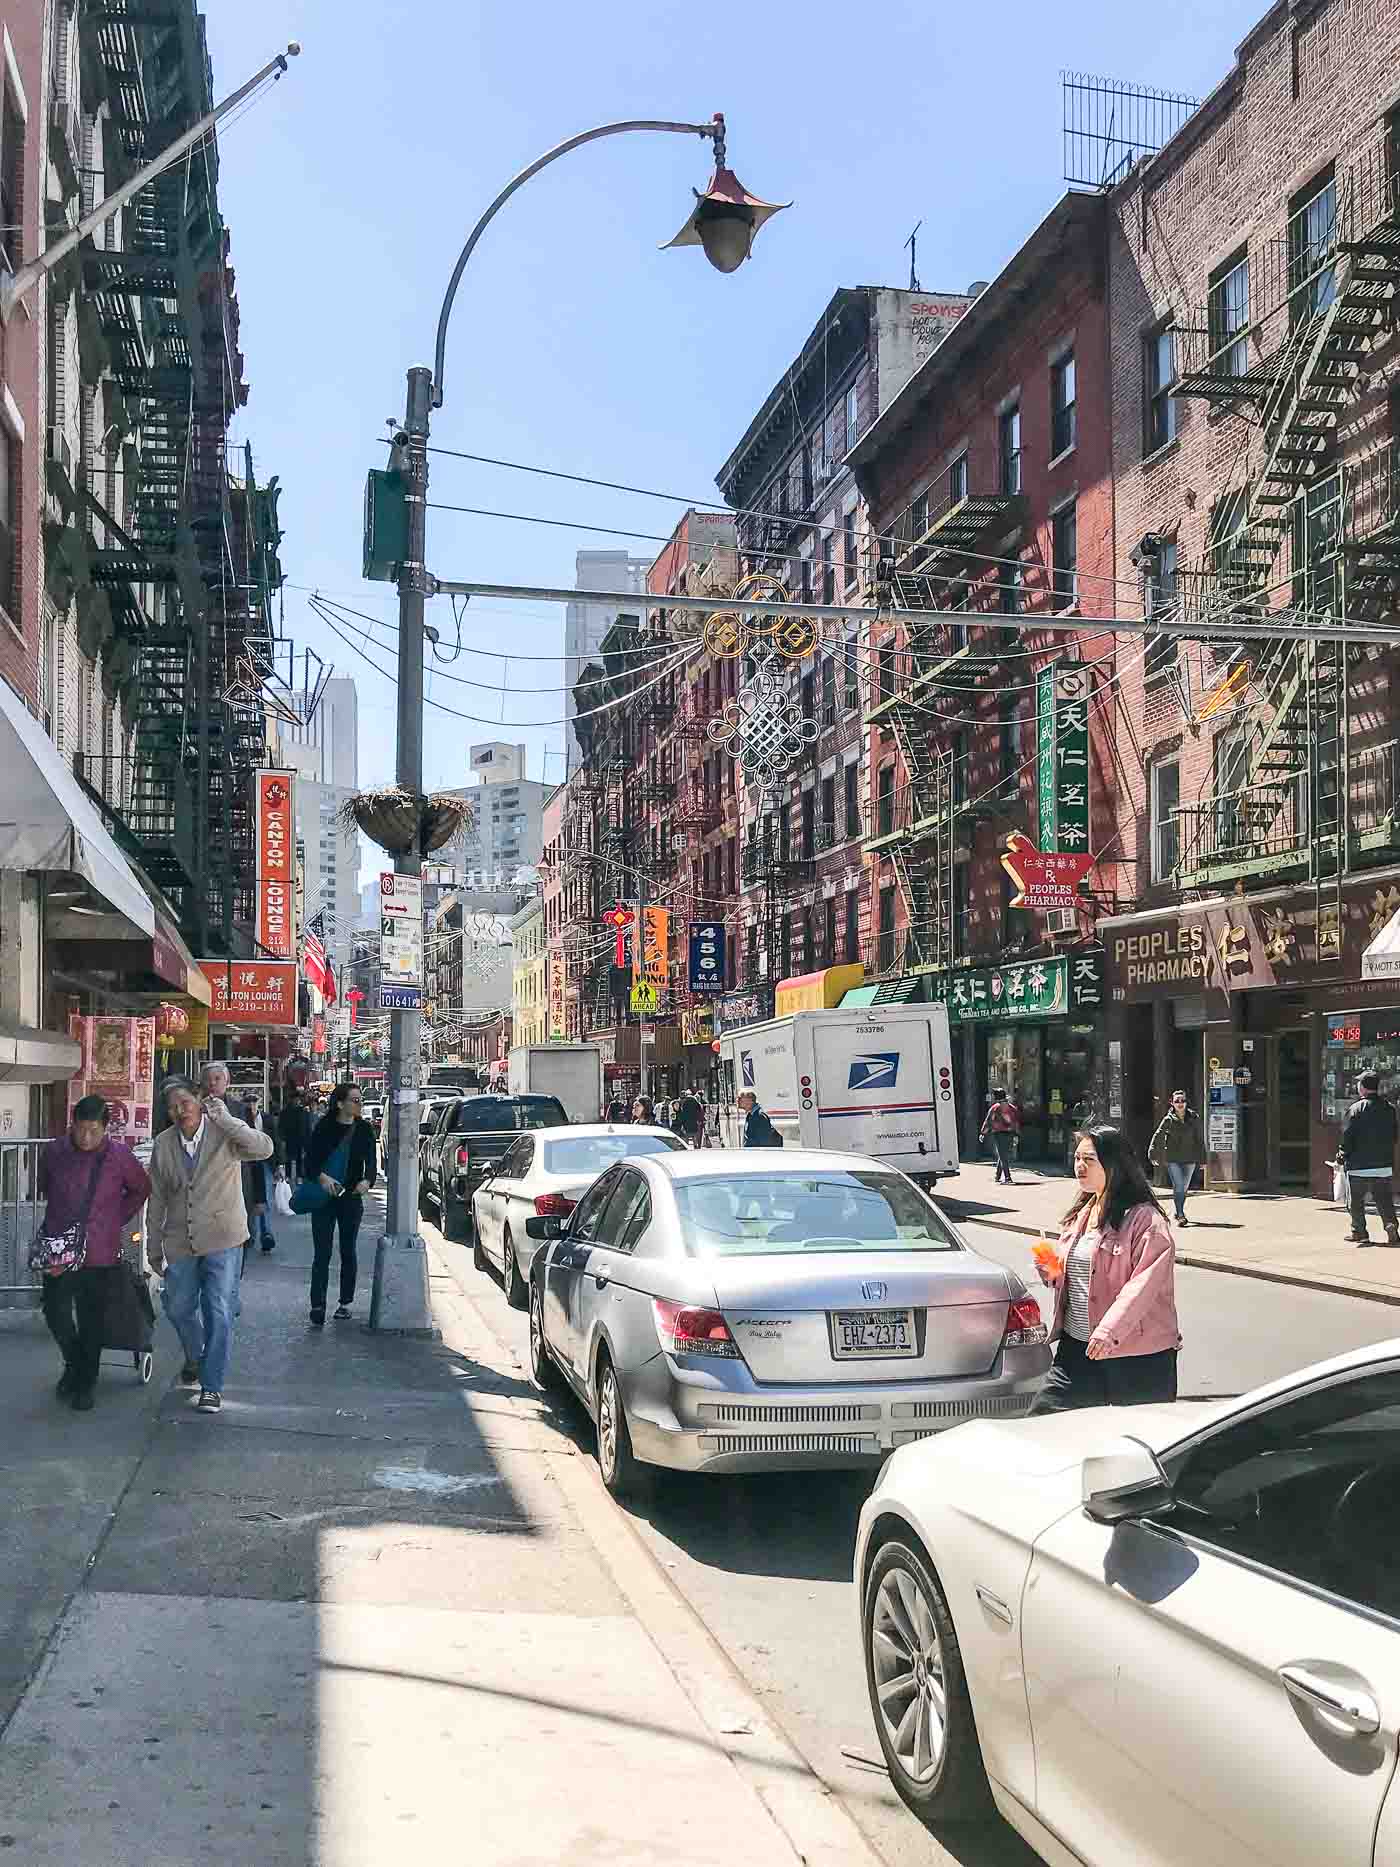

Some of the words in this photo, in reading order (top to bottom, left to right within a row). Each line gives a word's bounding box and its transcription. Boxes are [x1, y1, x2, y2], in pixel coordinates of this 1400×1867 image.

[1057, 706, 1087, 847] 天仁茗茶
[266, 811, 284, 868] CANTON
[1029, 884, 1073, 895] PEOPLES
[1023, 895, 1078, 906] PHARMACY
[384, 919, 392, 935] 2
[268, 935, 284, 945] 212
[1115, 924, 1203, 963] PEOPLES
[1127, 953, 1211, 986] PHARMACY
[1375, 960, 1393, 972] MOTT
[1073, 958, 1100, 1005] 天仁
[251, 991, 283, 1001] LOUNGE
[633, 1002, 654, 1010] AHEAD
